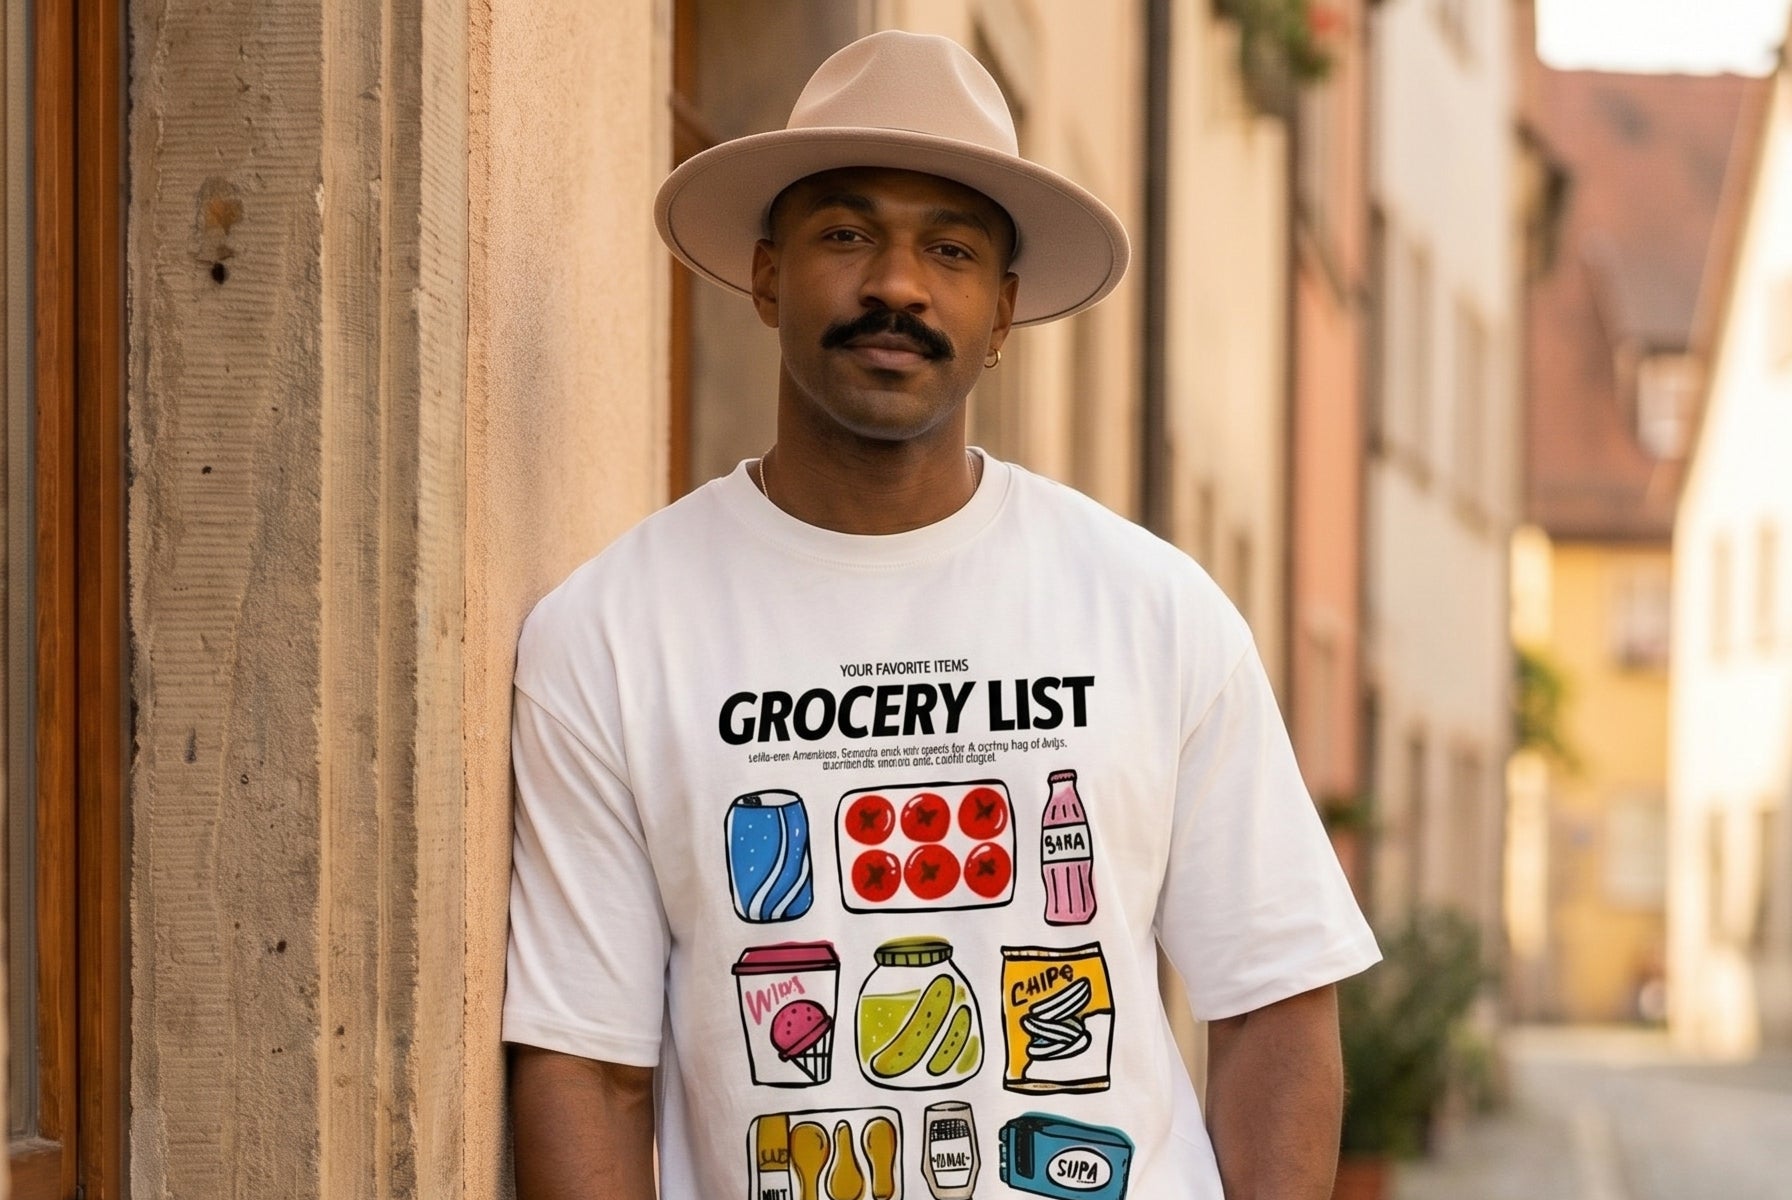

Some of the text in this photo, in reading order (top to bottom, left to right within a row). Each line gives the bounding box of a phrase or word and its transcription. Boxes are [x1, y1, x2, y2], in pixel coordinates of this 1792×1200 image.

[840, 659, 969, 677] YOUR FAVORITE ITEMS
[719, 676, 1095, 745] GROCERY LIST
